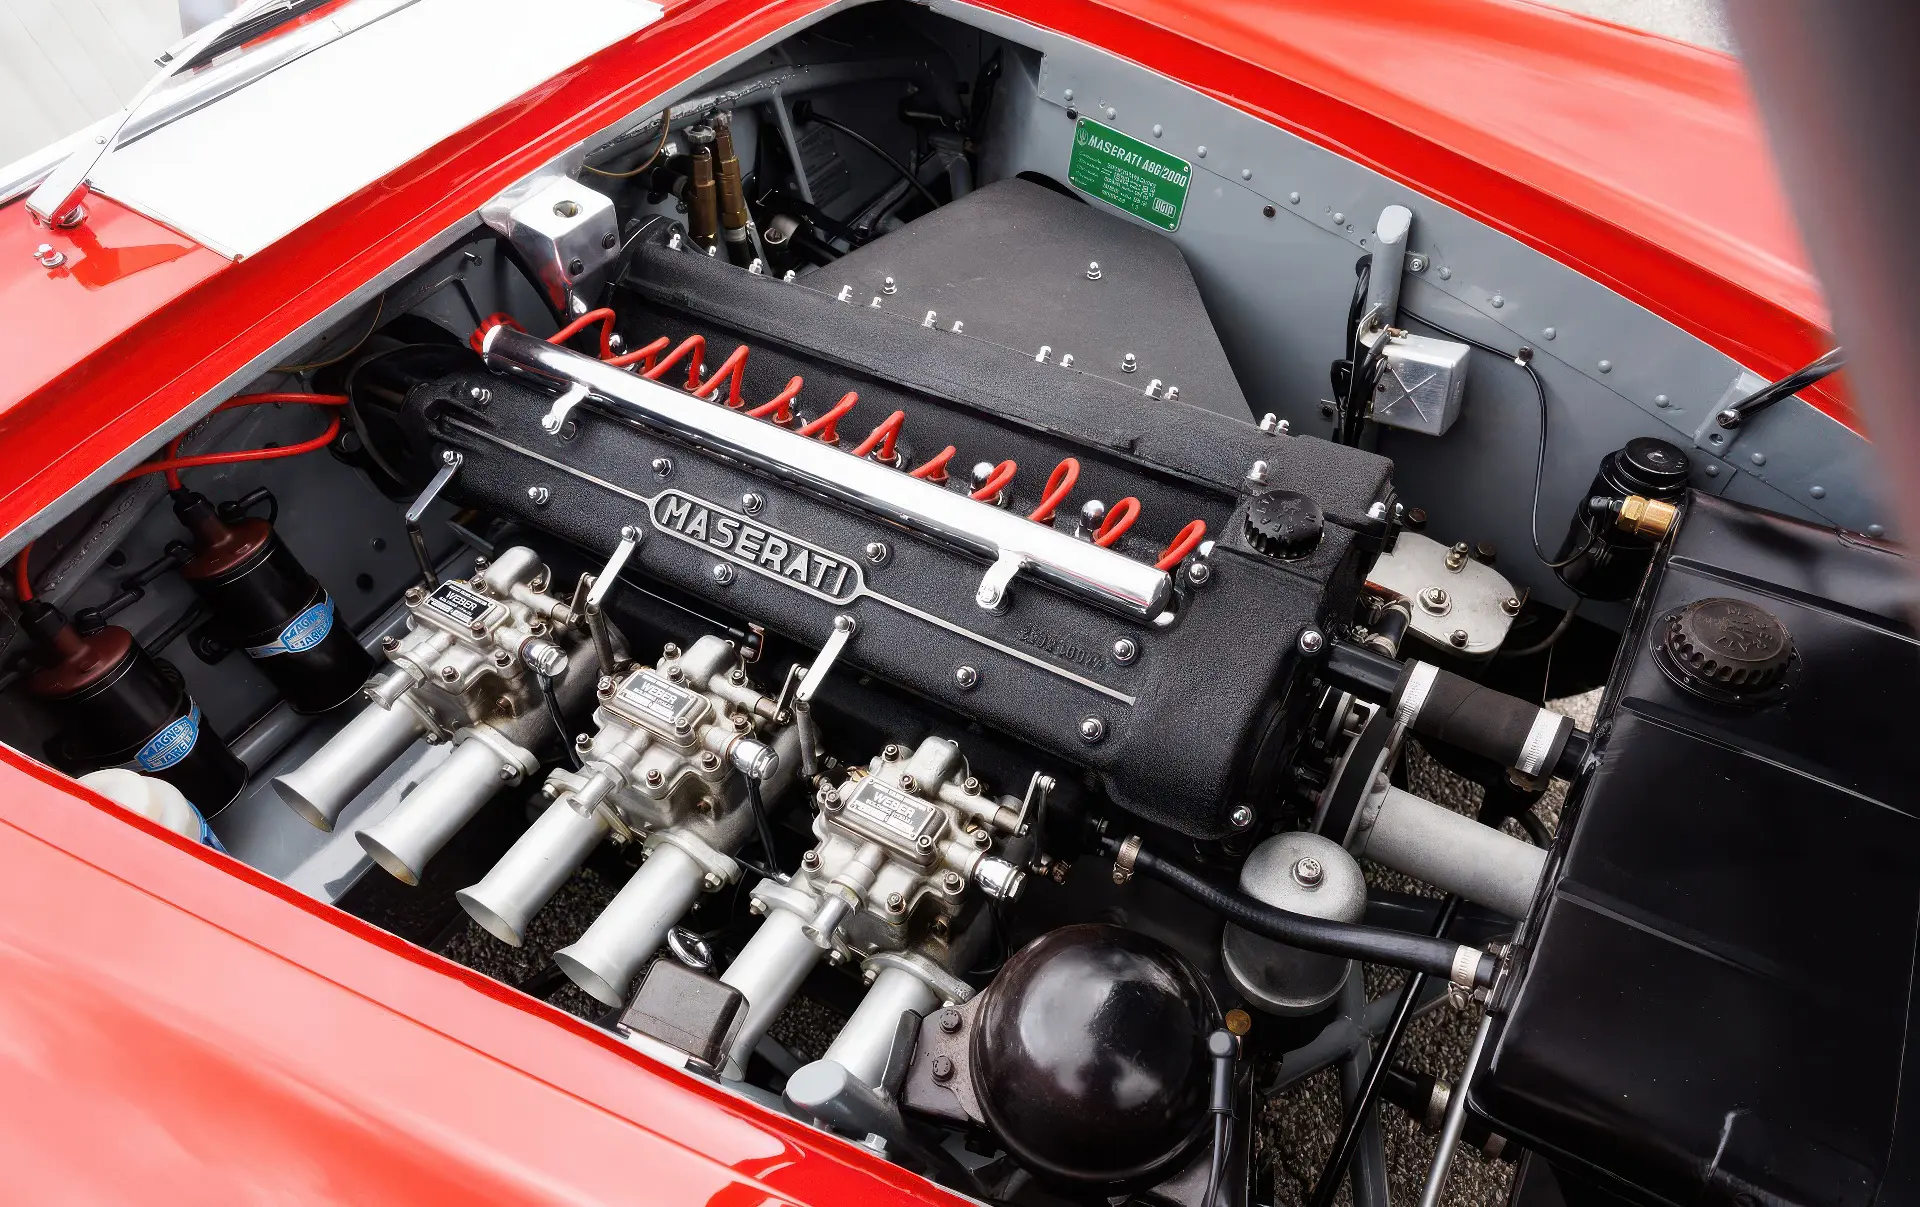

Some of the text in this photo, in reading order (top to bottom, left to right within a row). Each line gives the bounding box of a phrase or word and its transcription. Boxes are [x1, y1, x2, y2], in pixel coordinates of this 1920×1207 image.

[1088, 134, 1142, 167] MASERATI
[661, 495, 848, 596] MASERATI
[445, 590, 478, 611] WEBER
[640, 681, 678, 705] WEBER
[873, 791, 916, 819] WEBER
